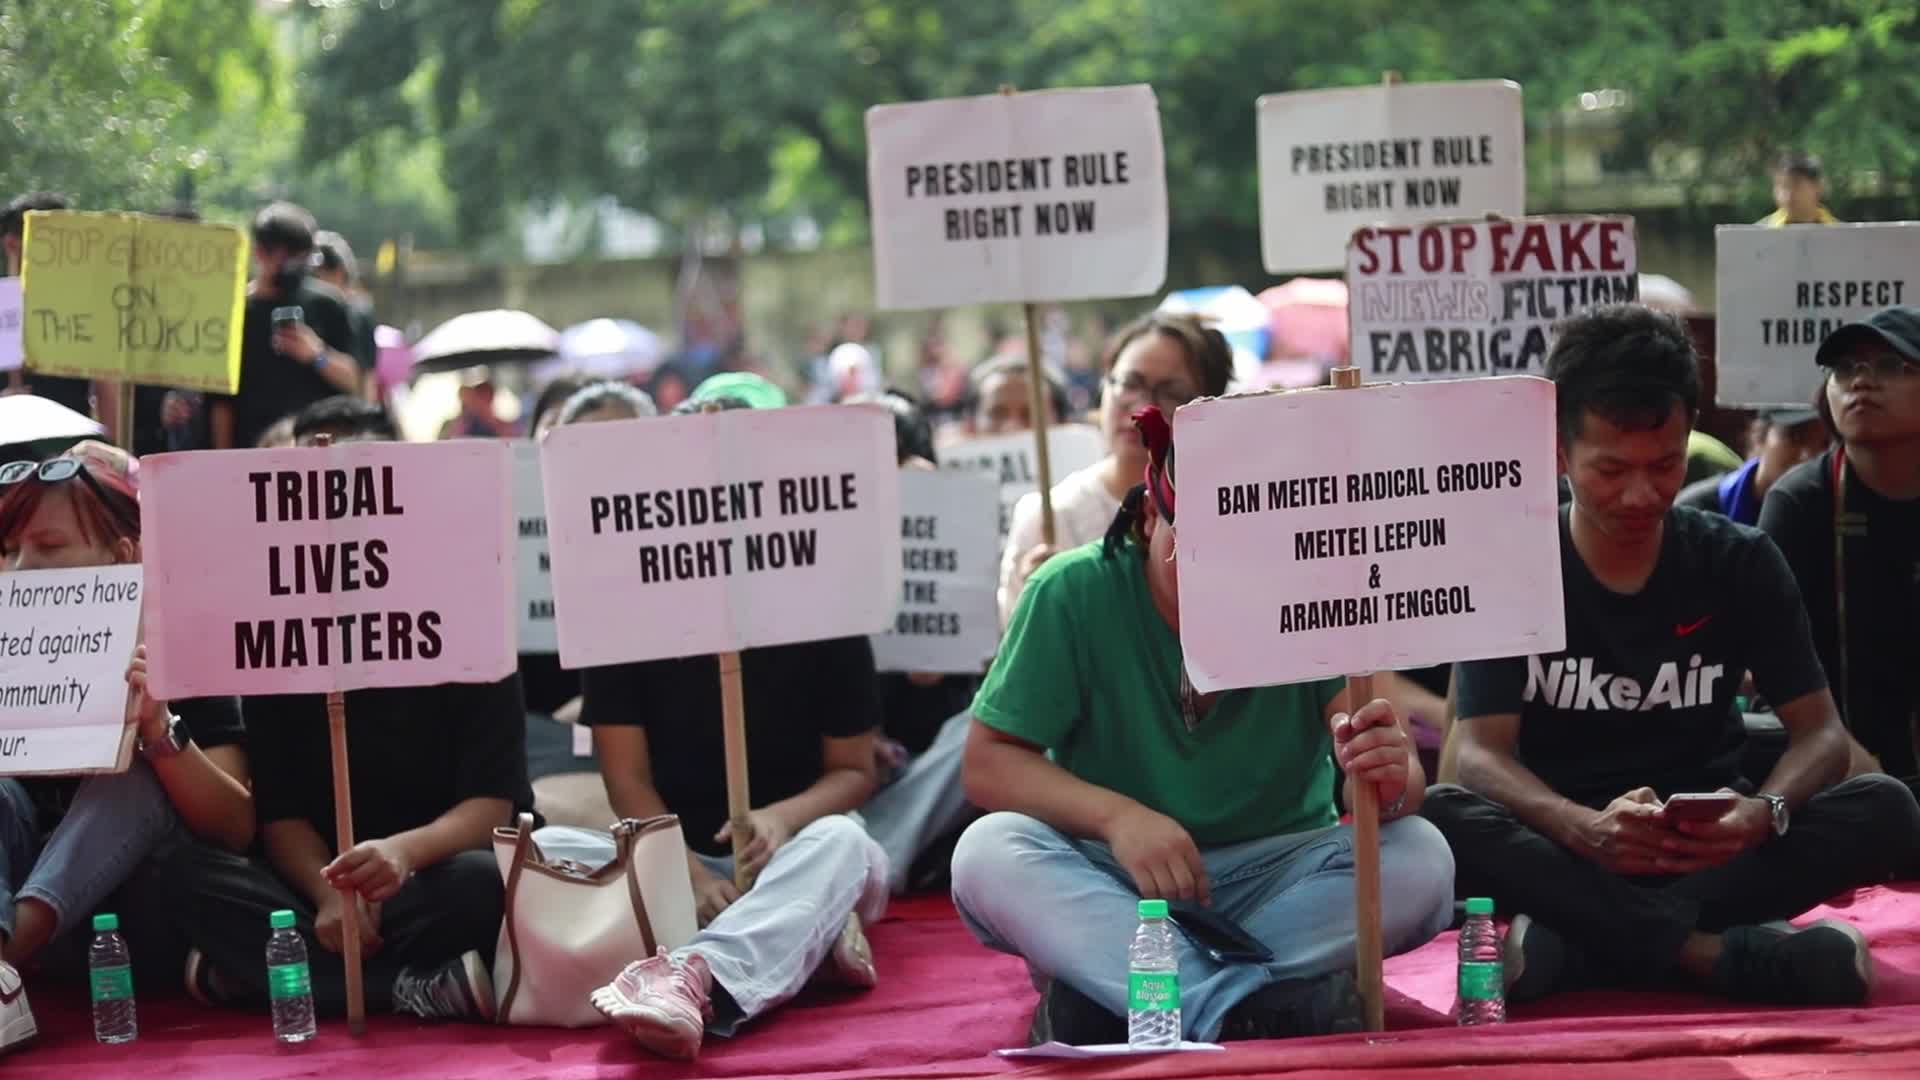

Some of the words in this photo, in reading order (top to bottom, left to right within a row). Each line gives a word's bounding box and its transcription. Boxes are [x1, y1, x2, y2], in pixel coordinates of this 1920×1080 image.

[906, 157, 1053, 198] PRESIDENT
[1064, 151, 1130, 188] RULE
[1291, 139, 1422, 174] PRESIDENT
[1432, 135, 1493, 168] RULE
[1324, 180, 1394, 213] RIGHT
[1404, 178, 1461, 207] NOW
[945, 204, 1022, 241] RIGHT
[1035, 200, 1096, 235] NOW
[32, 226, 104, 268] STOP
[1355, 225, 1477, 275] STOP
[1489, 221, 1625, 274] FAKE
[111, 281, 156, 312] ON
[1796, 280, 1905, 309] RESPECT
[33, 308, 95, 344] THE
[1370, 325, 1552, 374] FABRICA
[249, 465, 404, 523] TRIBAL
[590, 481, 764, 534] PRESIDENT
[779, 473, 858, 516] RULE
[1217, 483, 1260, 516] BAN
[1268, 475, 1338, 511] MEITEI
[1346, 467, 1430, 503] RADICAL
[1437, 459, 1522, 493] GROUPS
[639, 538, 733, 584] RIGHT
[745, 528, 817, 572] NOW
[1294, 526, 1367, 561] MEITEI
[1374, 518, 1446, 553] LEEPUN
[268, 539, 390, 596] LIVES
[1368, 563, 1381, 589] &
[9, 579, 87, 608] horrors
[92, 574, 139, 603] have
[1279, 596, 1378, 634] ARAMBAI
[1385, 585, 1476, 622] TENGGOL
[38, 625, 112, 664] against
[234, 610, 442, 669] MATTERS
